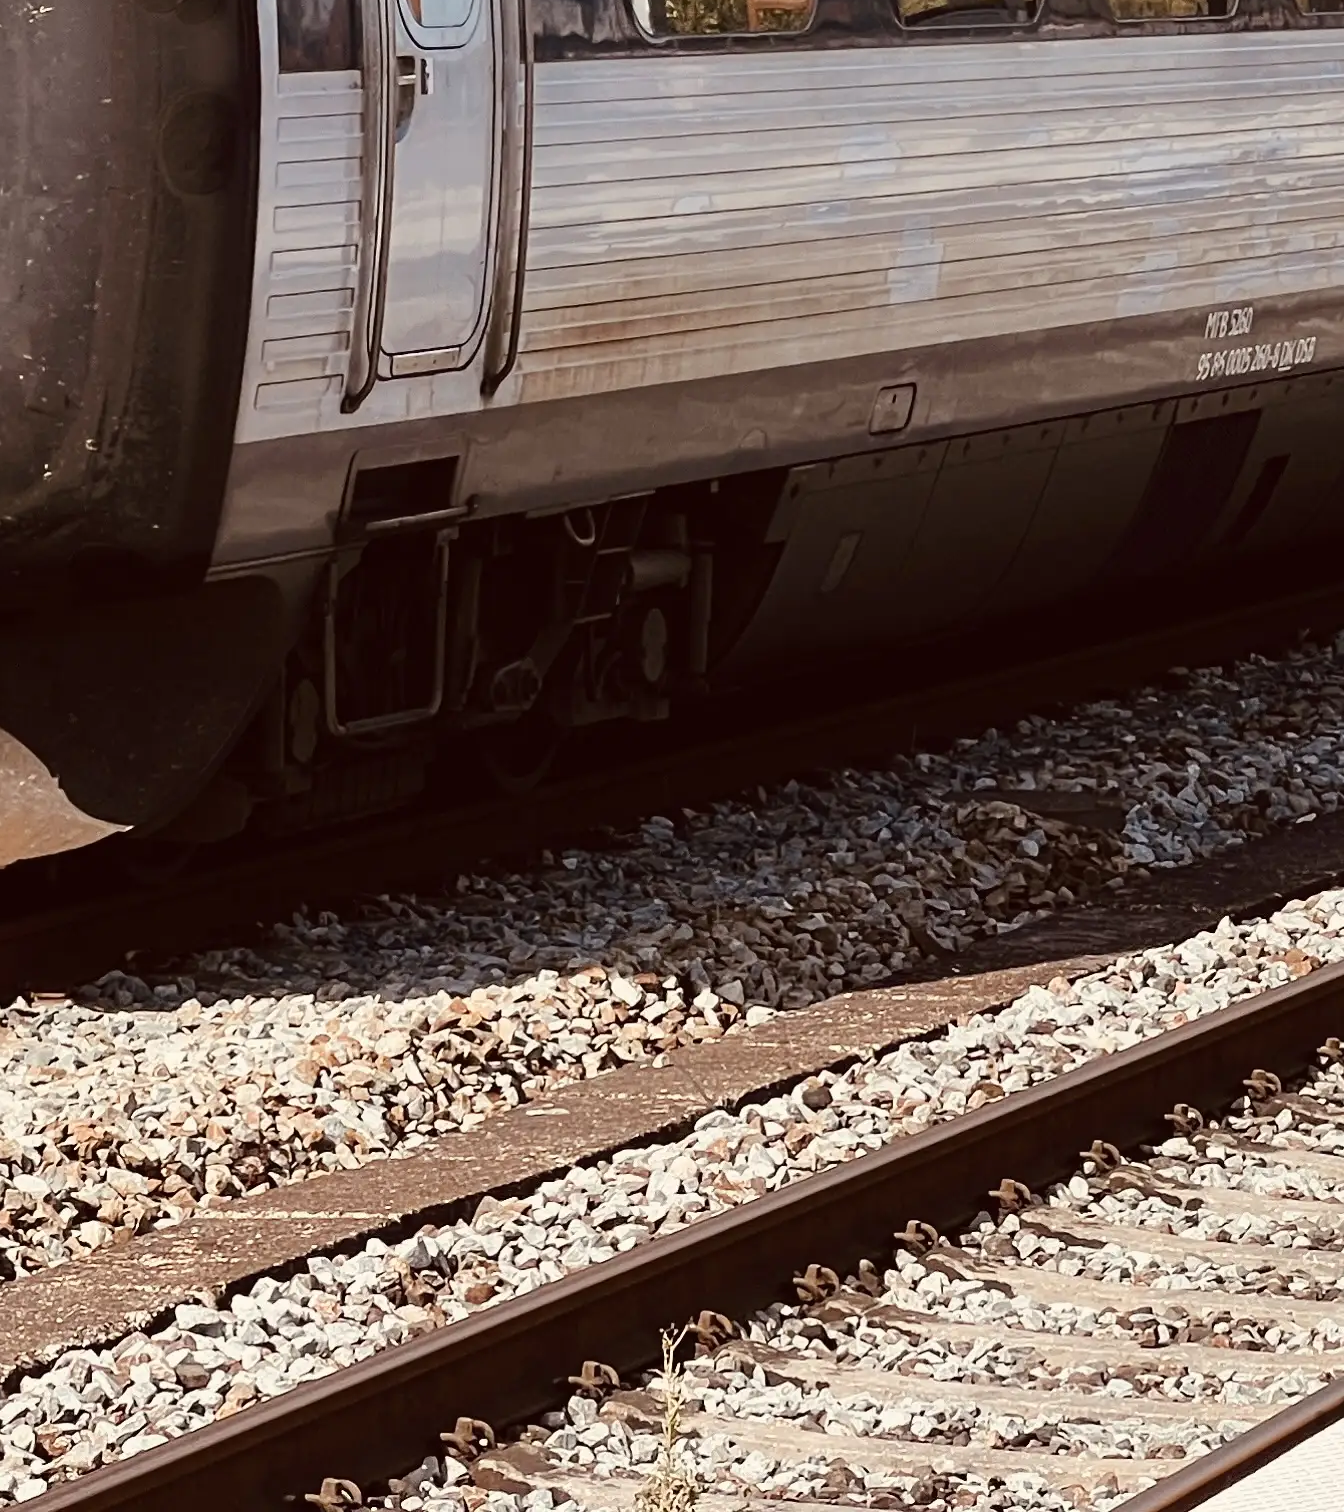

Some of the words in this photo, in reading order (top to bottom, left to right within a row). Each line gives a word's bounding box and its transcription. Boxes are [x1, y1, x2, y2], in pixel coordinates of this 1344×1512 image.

[1228, 306, 1254, 336] 5260
[1196, 352, 1213, 381] 95
[1294, 336, 1317, 364] DSB
